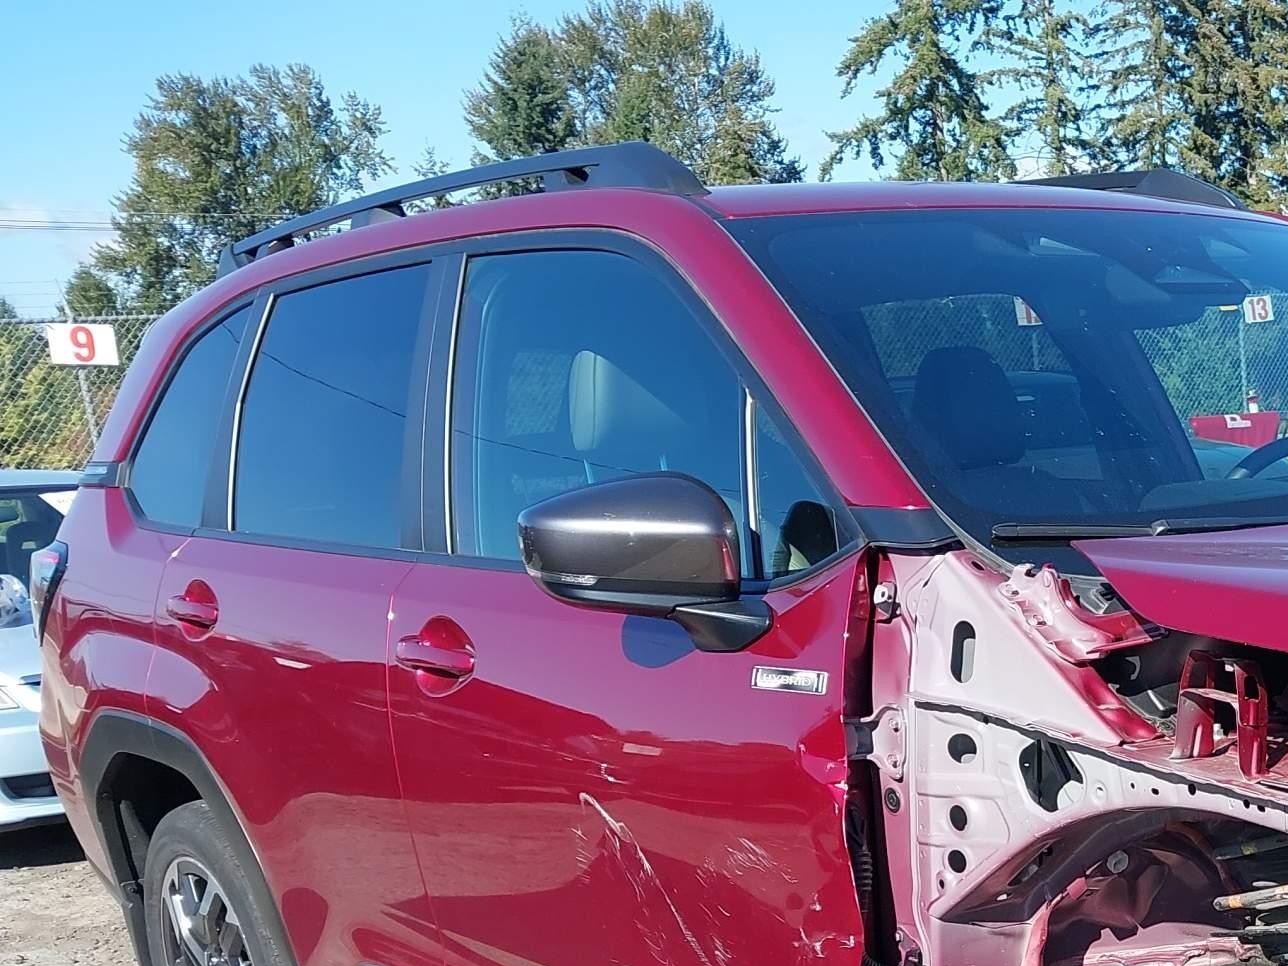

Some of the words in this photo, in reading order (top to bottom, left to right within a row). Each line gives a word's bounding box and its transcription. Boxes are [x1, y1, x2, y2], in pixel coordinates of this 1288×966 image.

[1247, 297, 1269, 321] 13
[70, 325, 96, 362] 9
[763, 673, 811, 687] HYBRID
